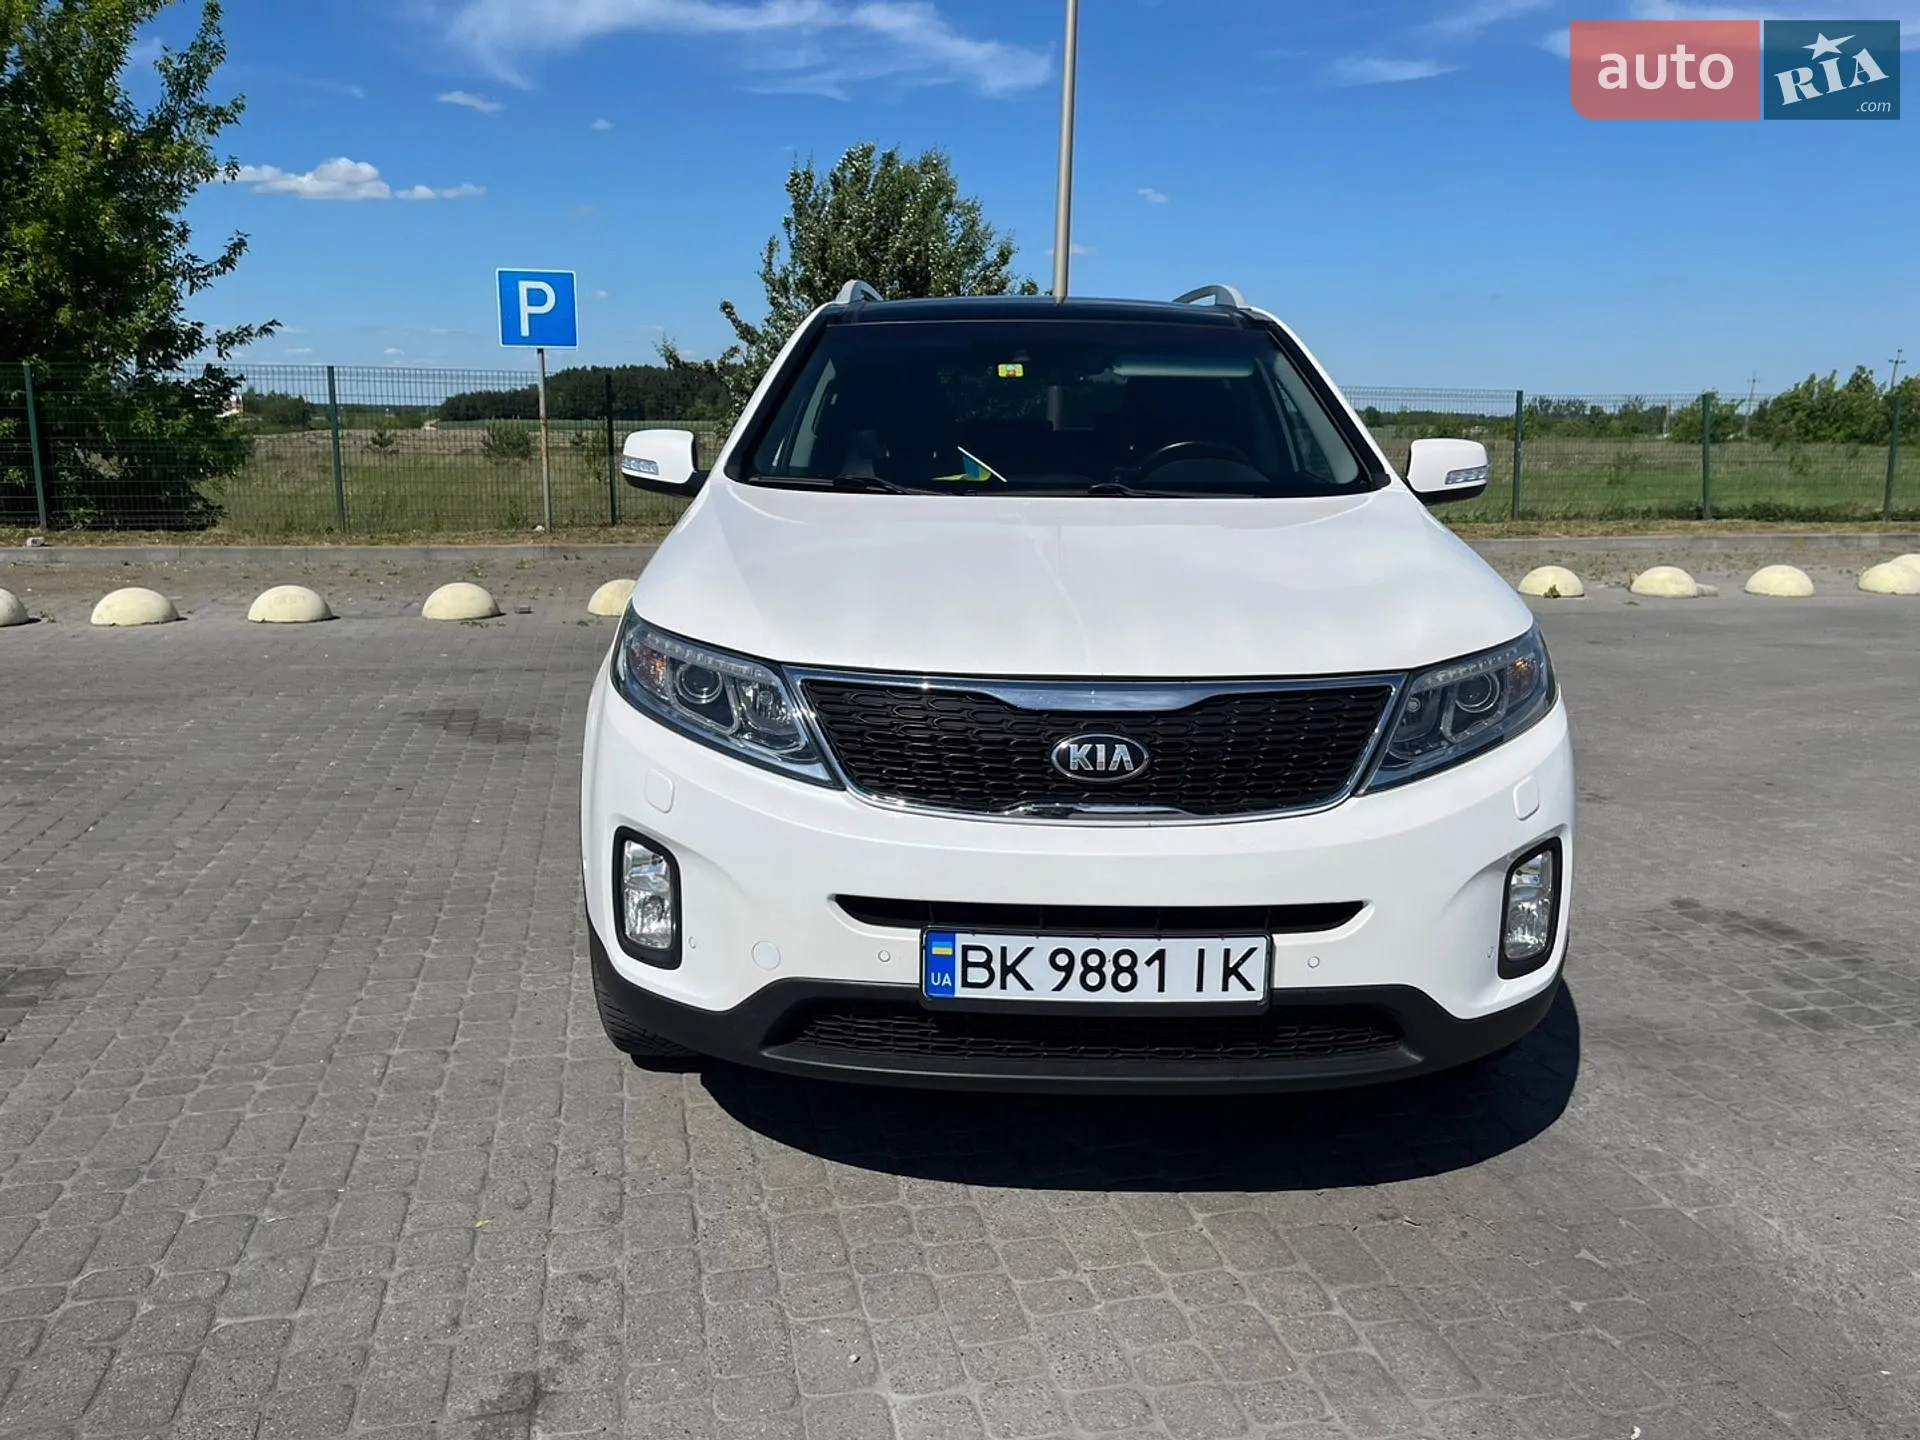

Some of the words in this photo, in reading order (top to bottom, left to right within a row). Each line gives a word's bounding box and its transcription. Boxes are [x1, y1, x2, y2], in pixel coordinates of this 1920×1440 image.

[518, 280, 556, 337] P
[1069, 743, 1134, 771] KIA
[930, 972, 952, 987] UA
[960, 944, 1035, 992] BK
[1048, 946, 1167, 994] 9881
[1195, 946, 1259, 993] IK
